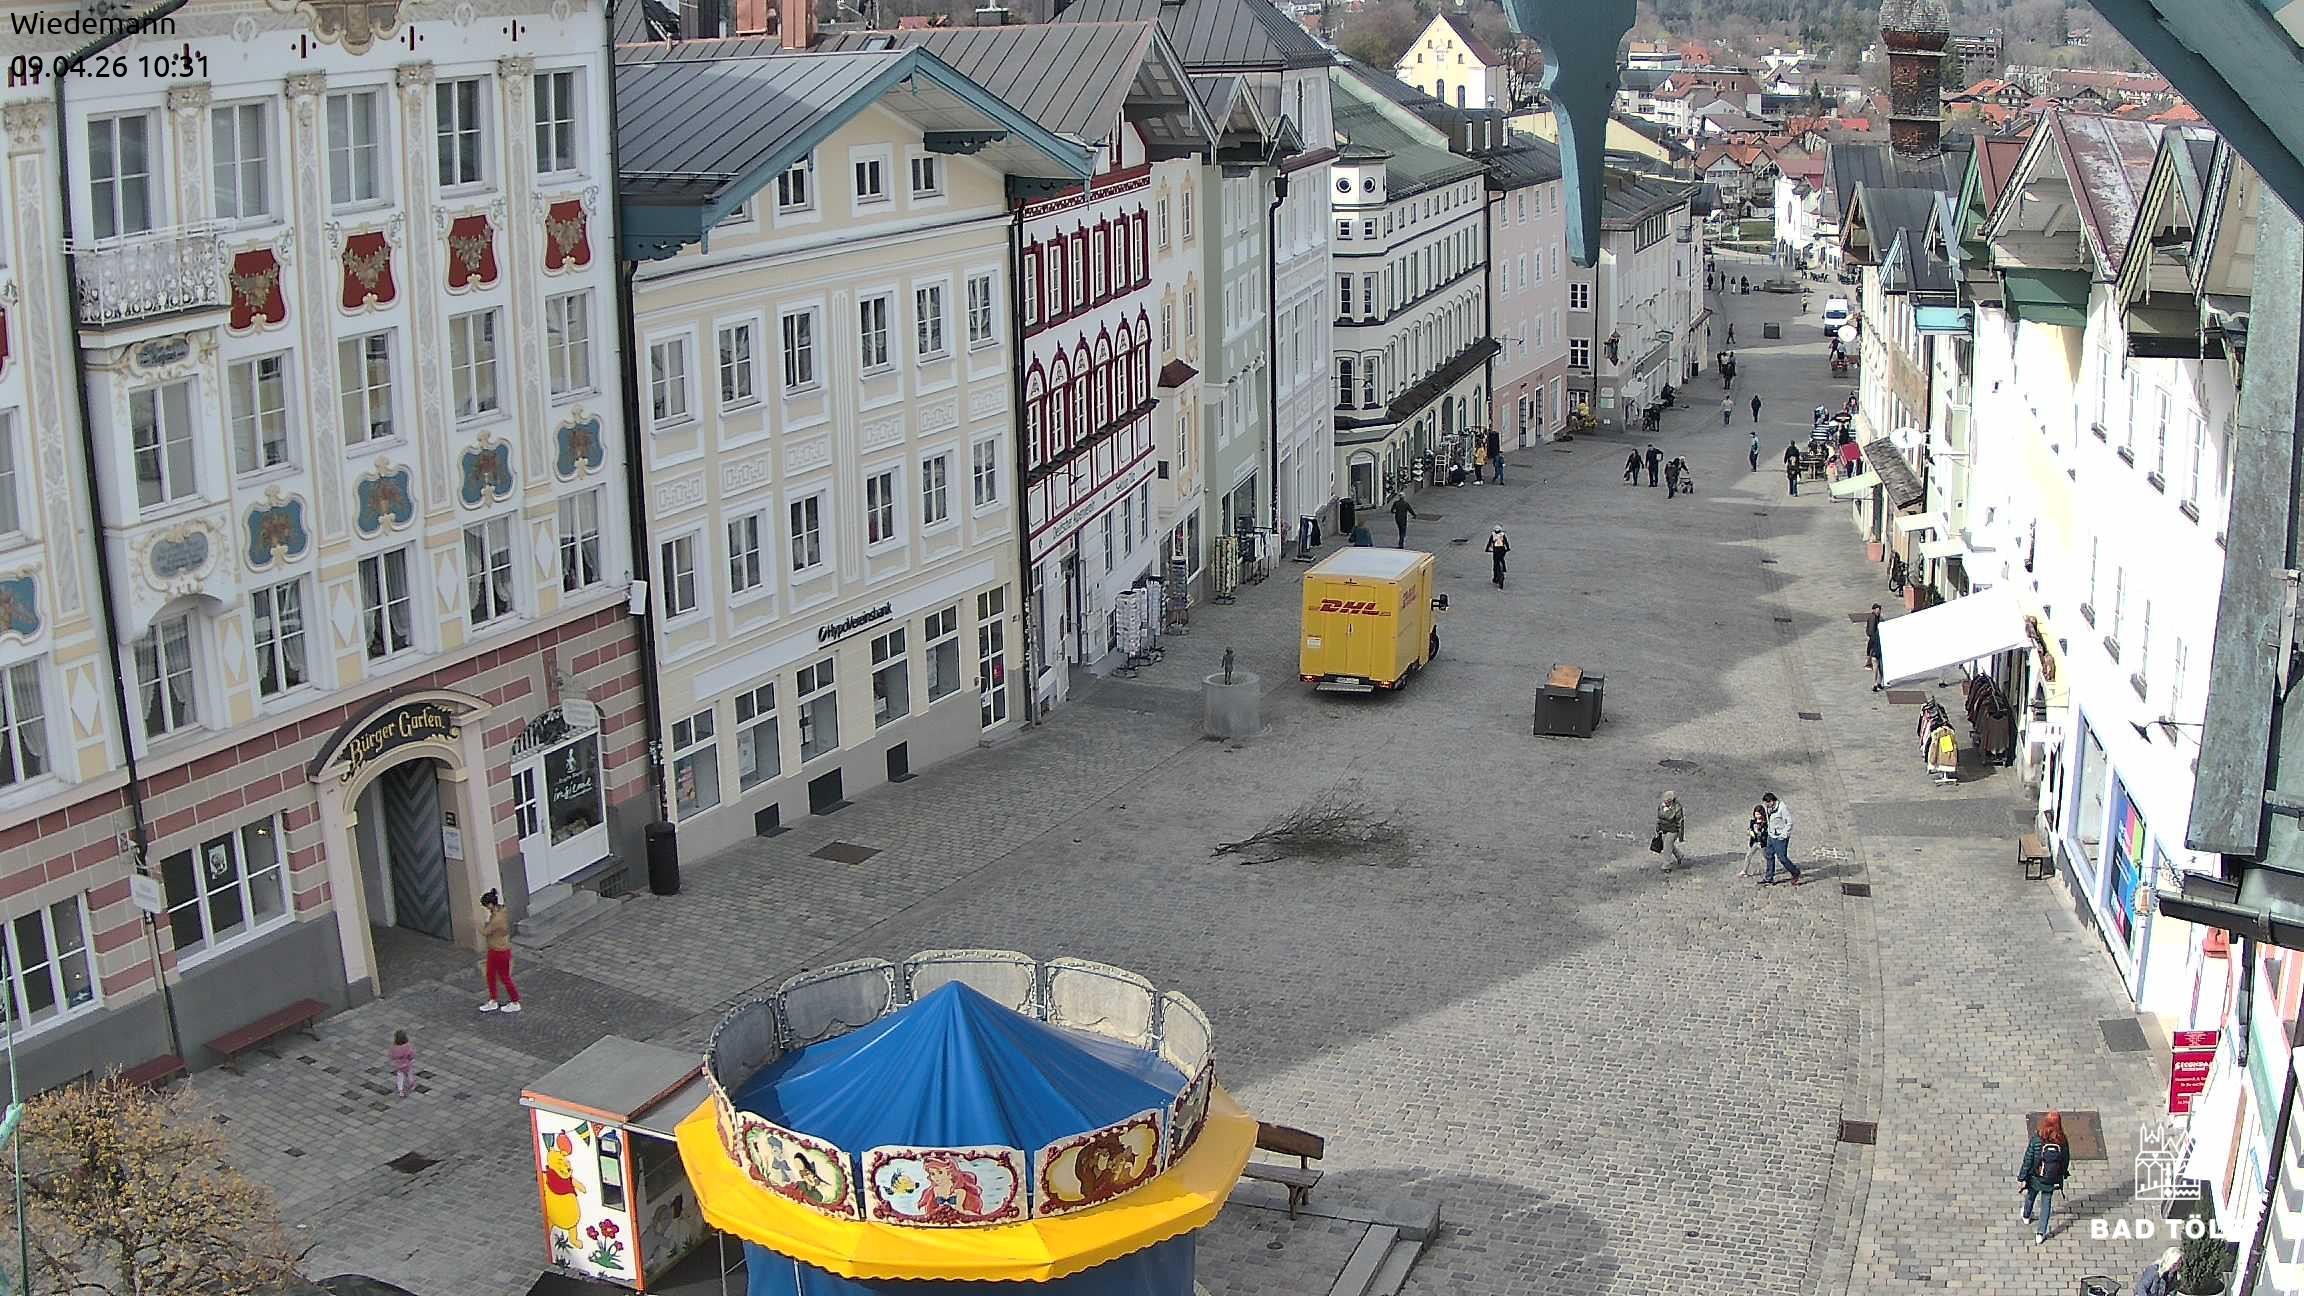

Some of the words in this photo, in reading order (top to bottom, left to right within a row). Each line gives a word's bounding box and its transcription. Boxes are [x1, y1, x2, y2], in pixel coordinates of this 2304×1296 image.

[827, 600, 893, 640] HypoVereinsbank
[1320, 599, 1380, 616] DHL
[350, 722, 396, 764] Bürger
[398, 706, 443, 738] Garten
